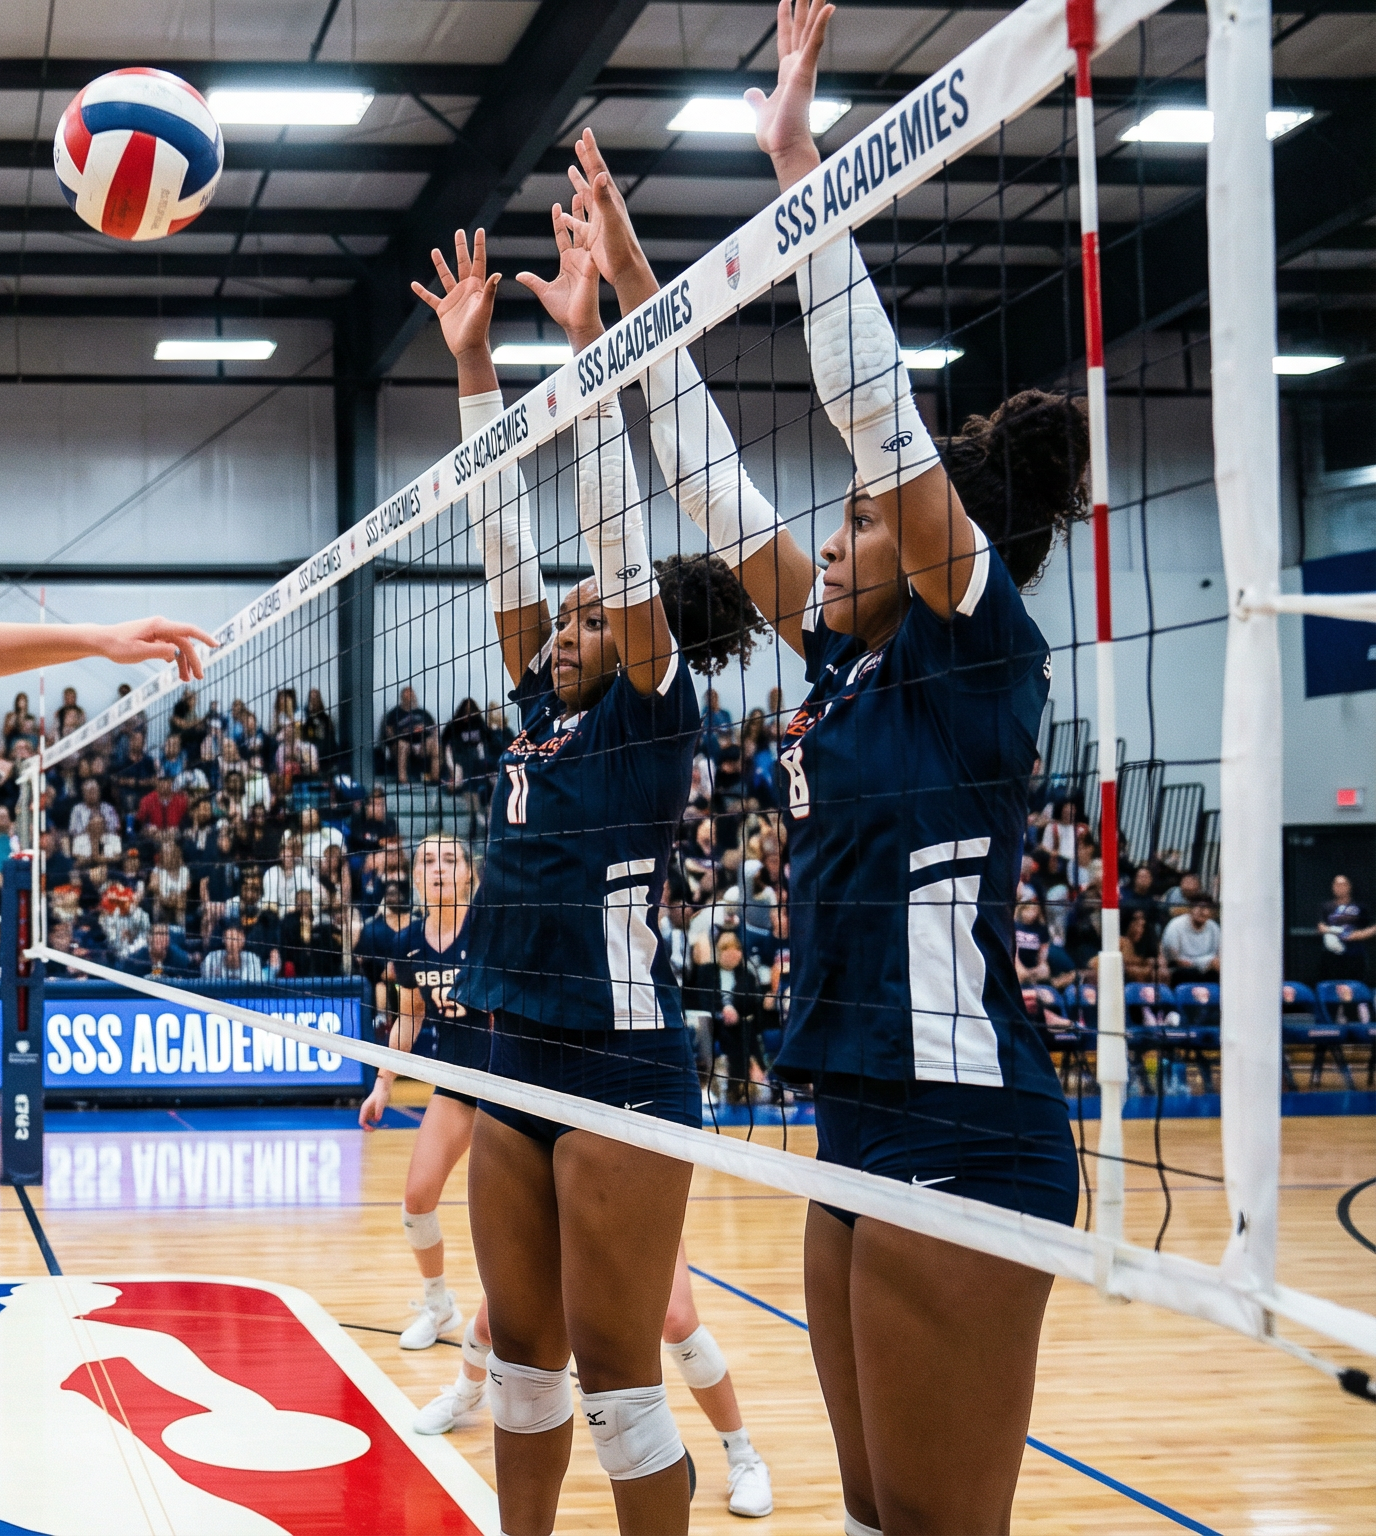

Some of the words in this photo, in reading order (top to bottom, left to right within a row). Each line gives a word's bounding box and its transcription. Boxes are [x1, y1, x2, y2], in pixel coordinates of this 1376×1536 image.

[775, 184, 817, 255] SSS
[824, 68, 969, 226] ACADEMIES
[578, 346, 604, 397] SSS
[608, 279, 692, 380] ACADEMIES
[454, 446, 472, 486] SSS
[474, 403, 529, 474] ACADEMIES
[47, 1013, 123, 1075] SSS
[130, 1011, 343, 1074] ACADEMIES
